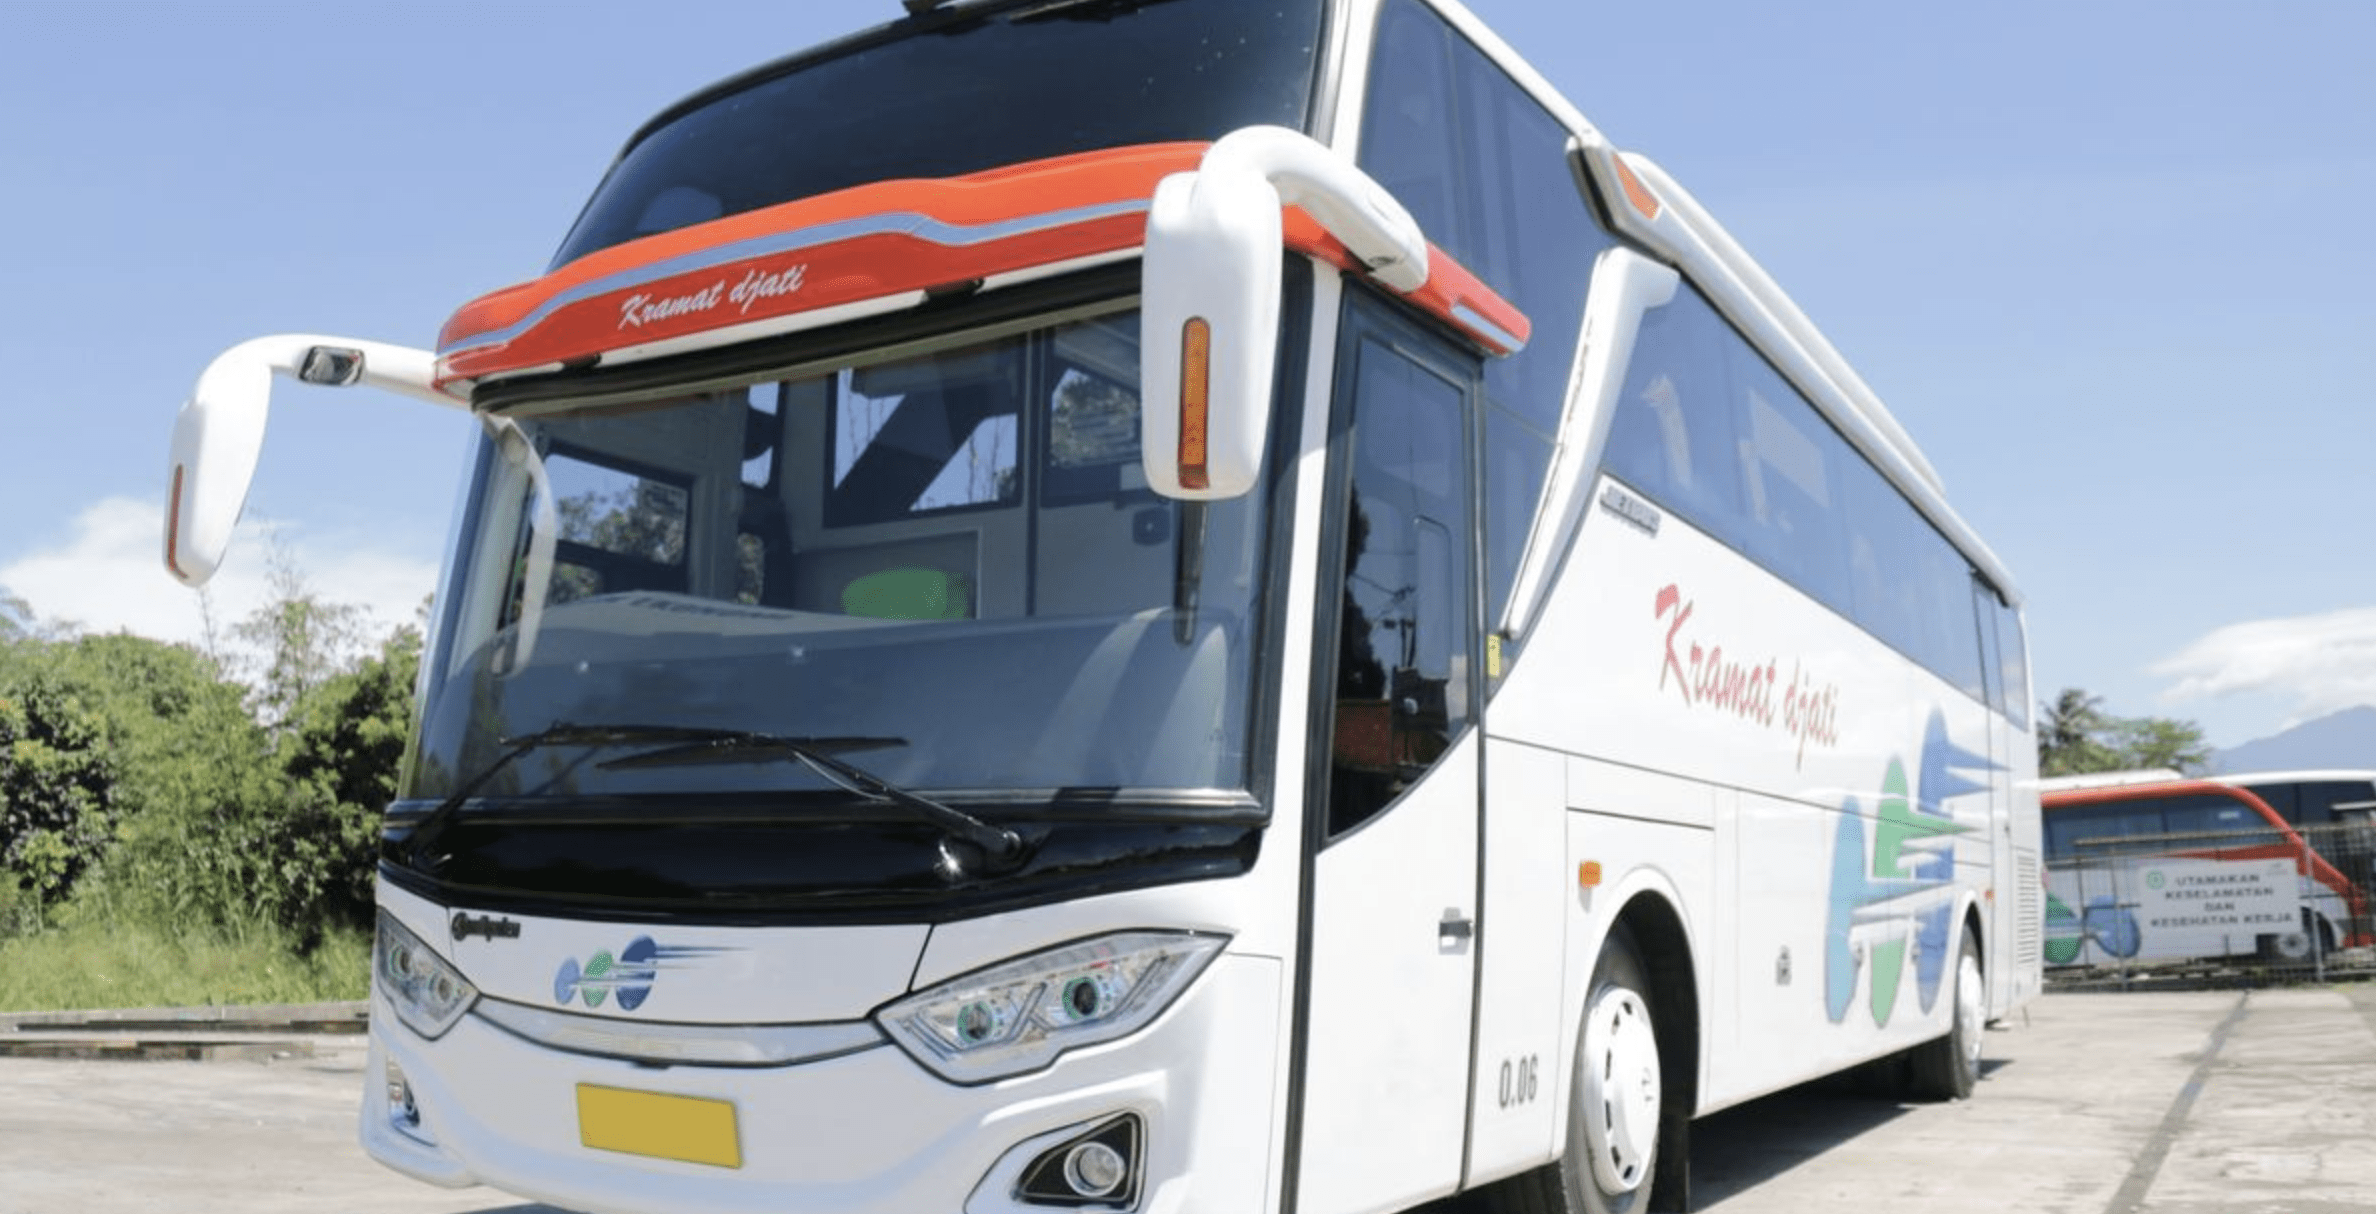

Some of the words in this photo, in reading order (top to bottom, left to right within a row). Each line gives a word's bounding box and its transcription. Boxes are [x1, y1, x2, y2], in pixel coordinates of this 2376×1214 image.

[618, 280, 725, 330] Kramat
[729, 264, 808, 315] djati
[1655, 583, 1776, 728] Kramat
[1784, 657, 1839, 773] djati
[2175, 875, 2260, 886] UTAMAKAN
[2165, 887, 2273, 899] KESELAMATAN
[2205, 901, 2235, 912] DAN
[2151, 915, 2239, 927] KESEHATAN
[2244, 912, 2292, 924] KERJA
[1499, 1055, 1538, 1108] 0.06
